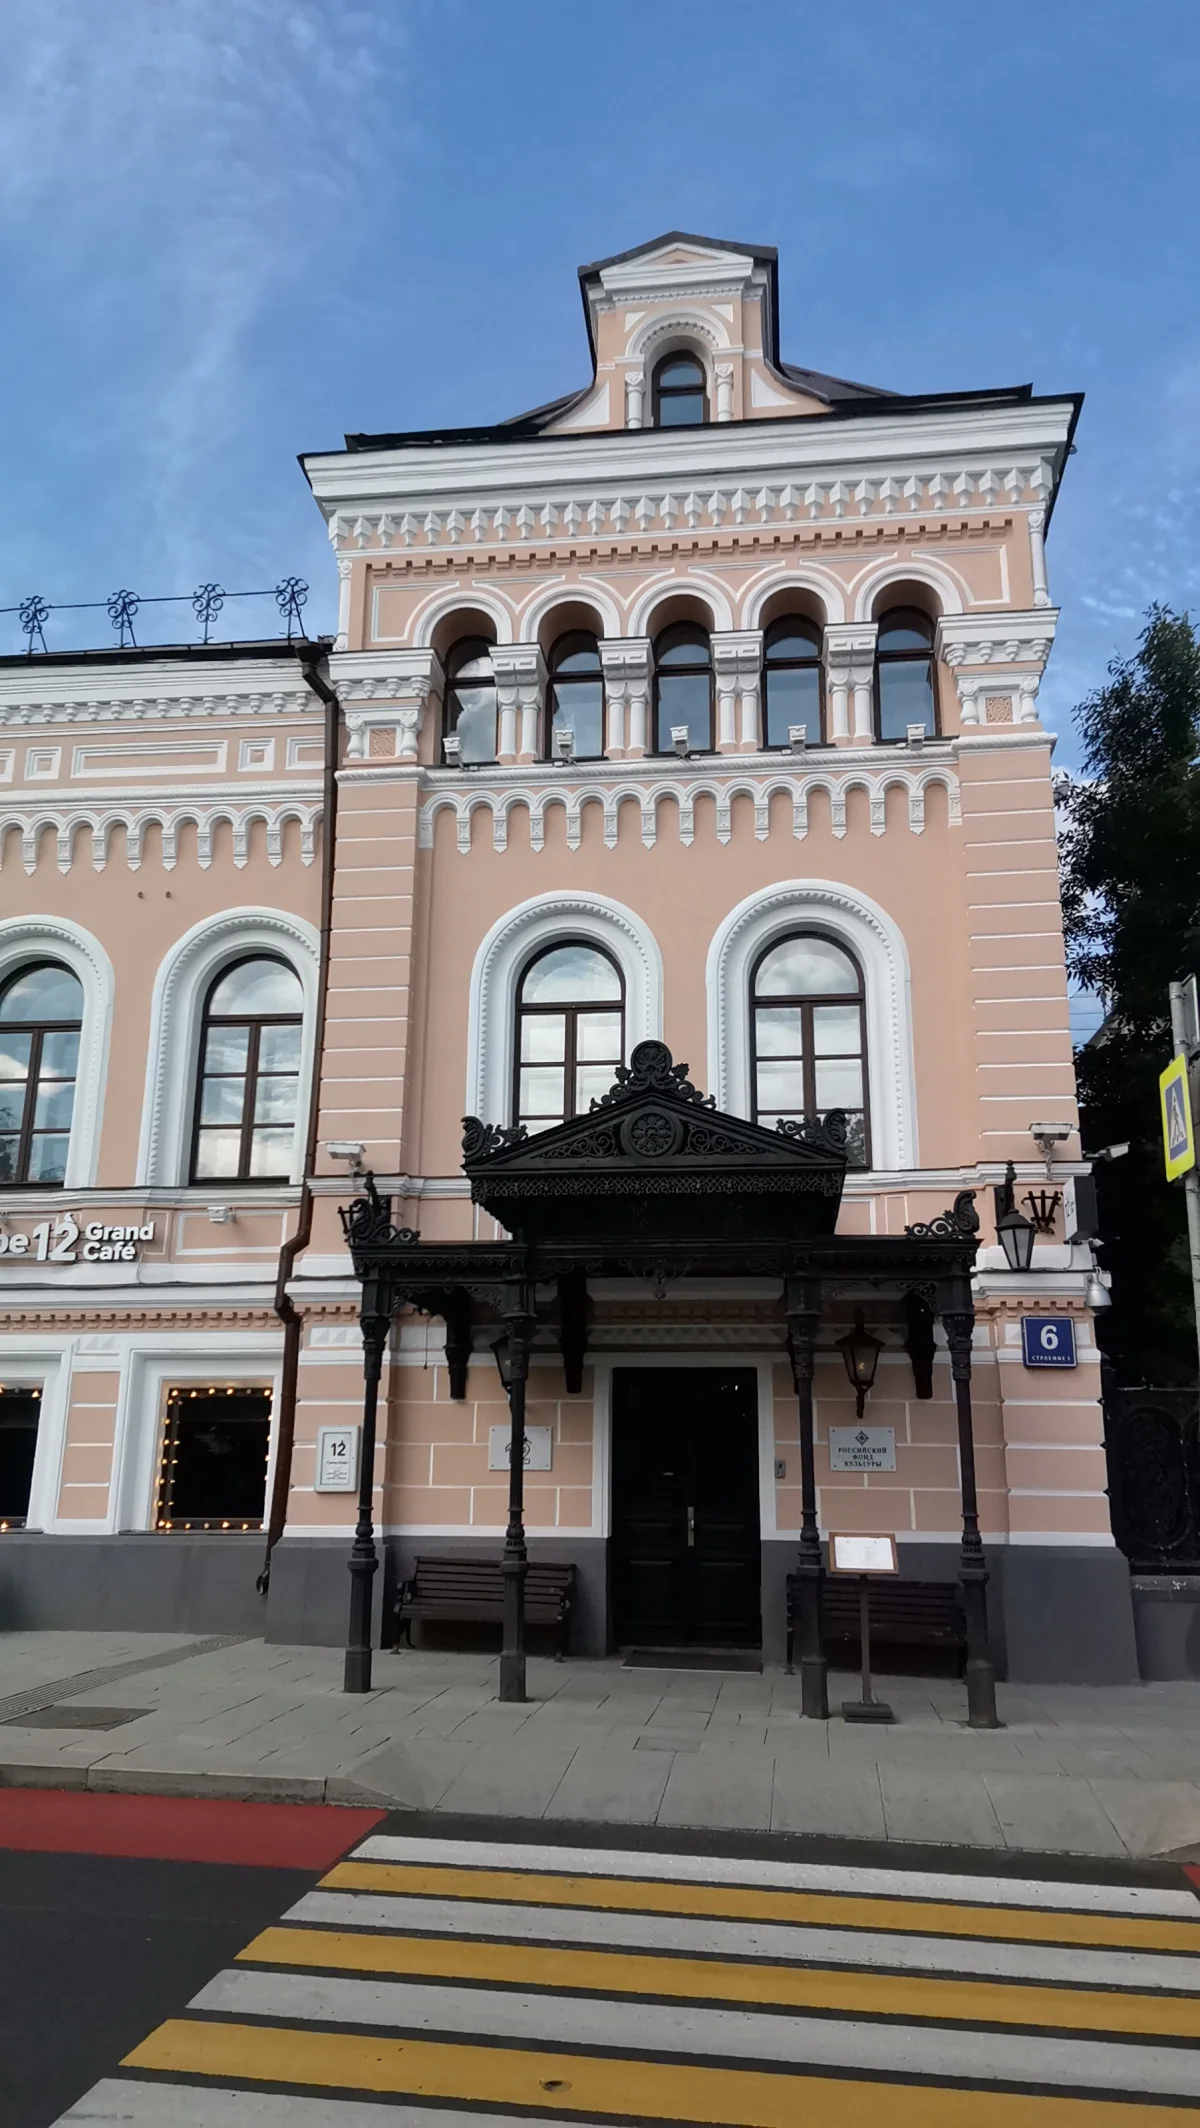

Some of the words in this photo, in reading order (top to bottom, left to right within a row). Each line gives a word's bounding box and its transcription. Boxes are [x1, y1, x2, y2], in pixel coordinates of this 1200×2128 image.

[85, 1222, 155, 1241] Grand
[32, 1222, 79, 1261] 12
[83, 1241, 136, 1260] Café
[1040, 1324, 1059, 1350] 6
[331, 1442, 346, 1456] 12
